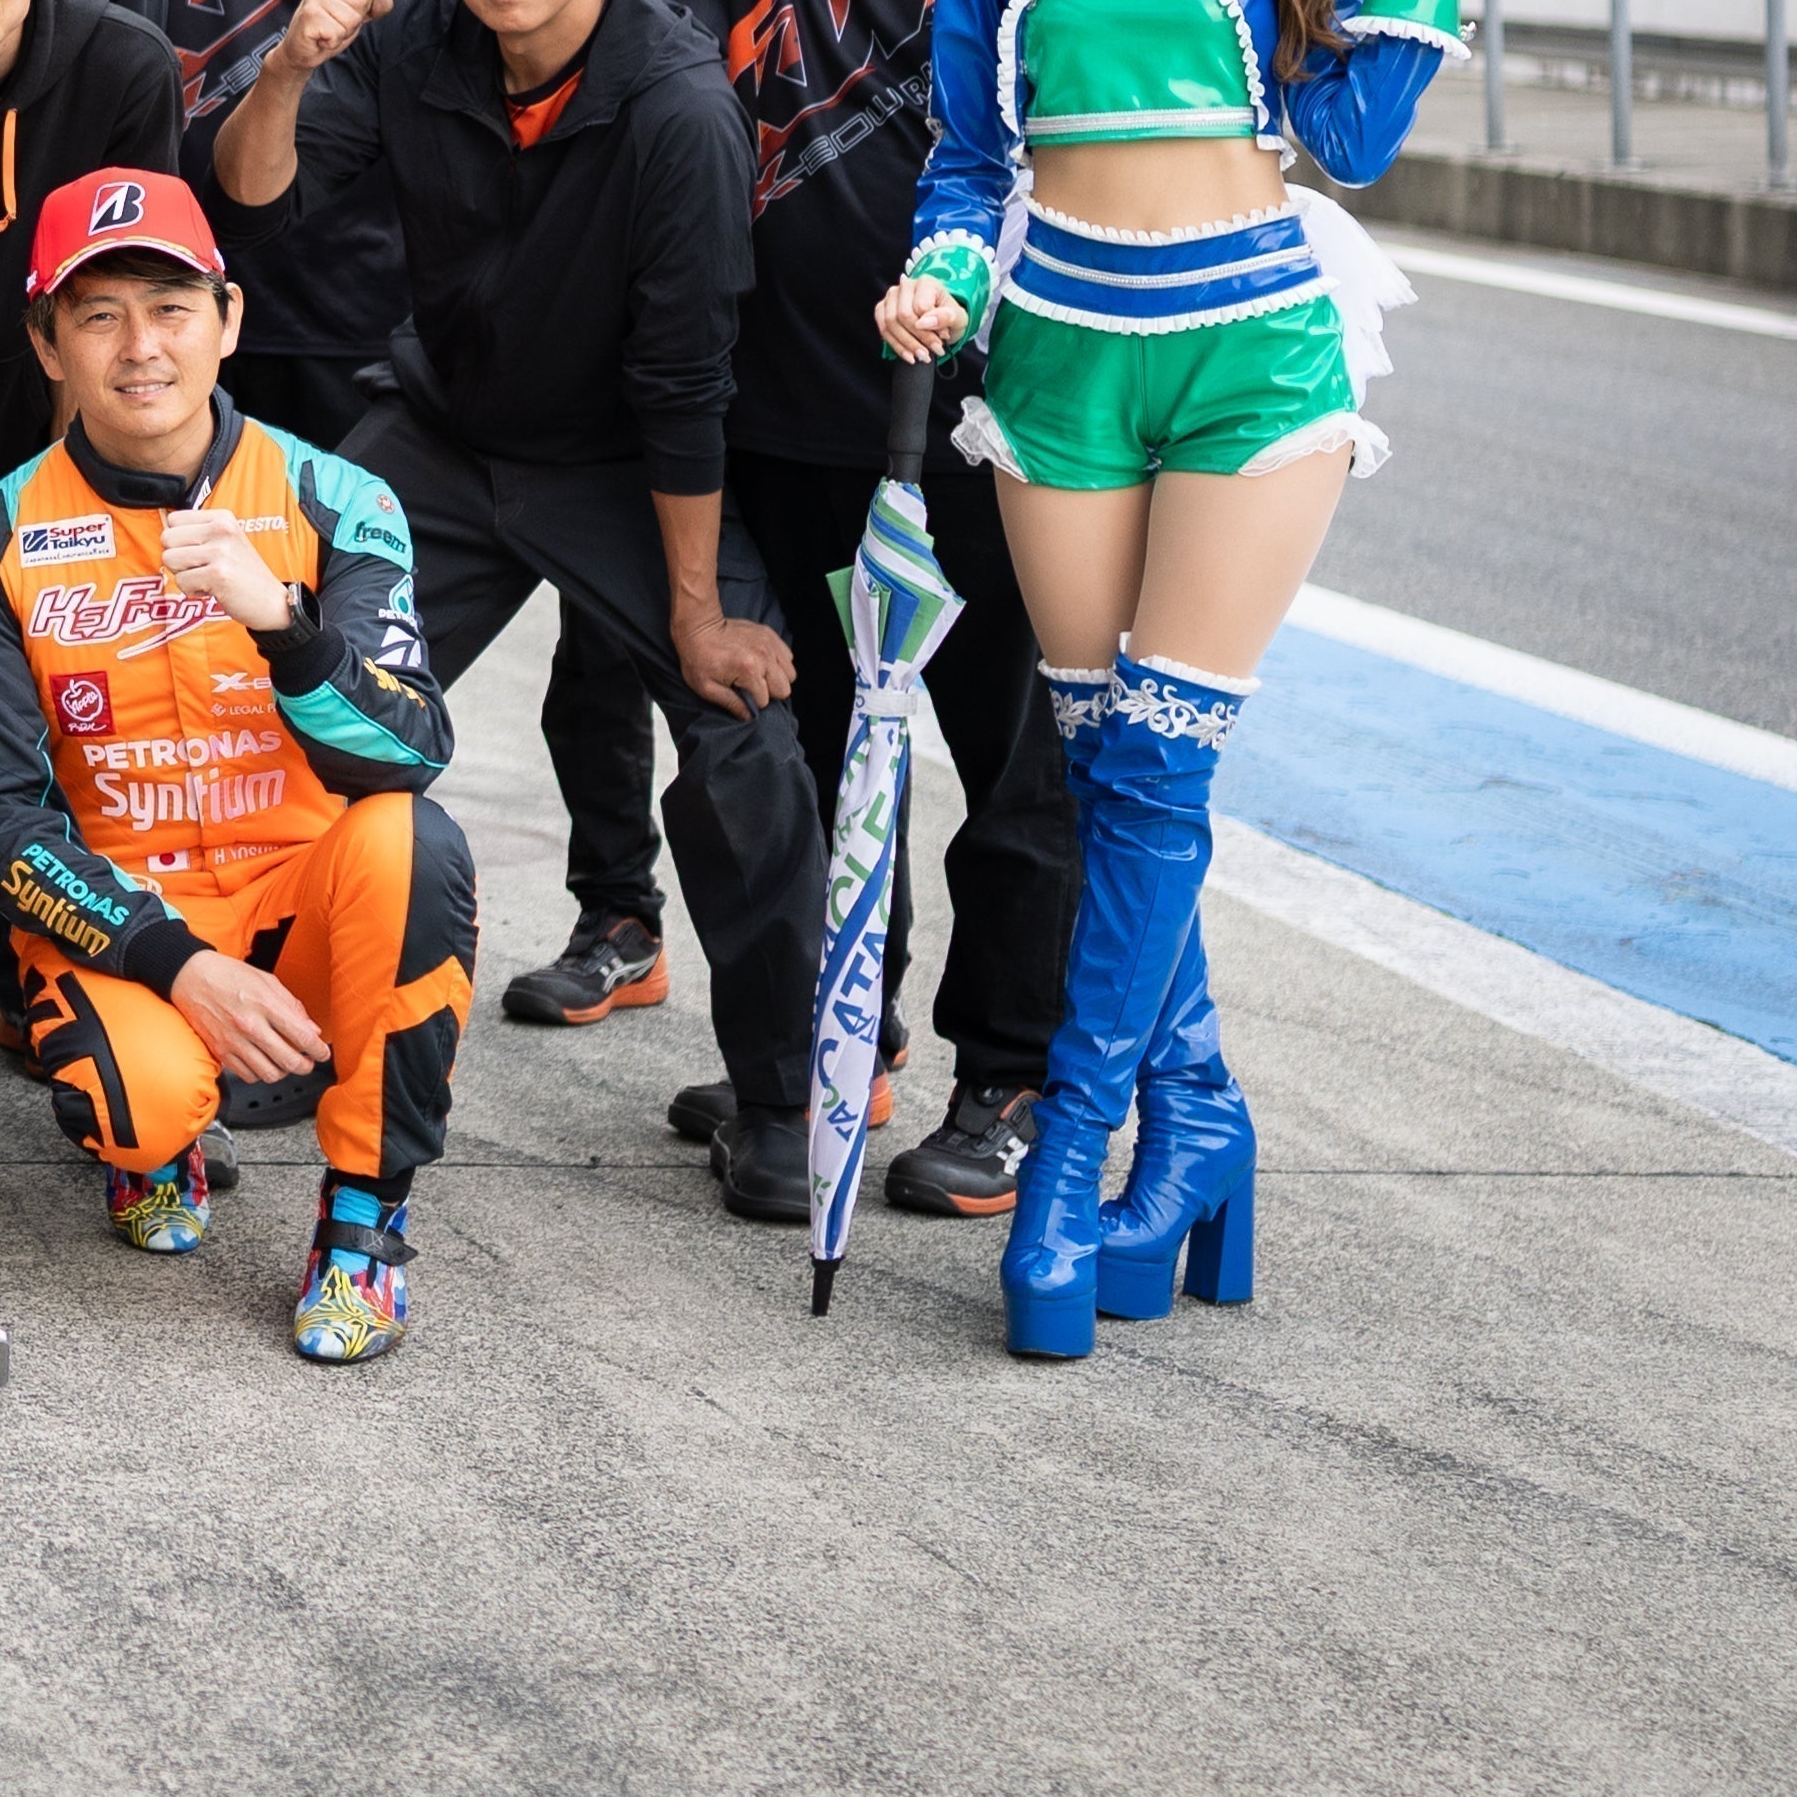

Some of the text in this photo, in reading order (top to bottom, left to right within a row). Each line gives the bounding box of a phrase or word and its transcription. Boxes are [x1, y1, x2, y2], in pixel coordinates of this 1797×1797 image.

[49, 521, 107, 538] Super
[49, 534, 107, 550] Taikyu
[356, 520, 408, 554] freem
[228, 704, 265, 717] LEGAL
[82, 729, 283, 769] PETRONAS
[94, 767, 287, 833] Syntium
[21, 843, 131, 926] PETRONAS
[0, 860, 112, 958] Syntium
